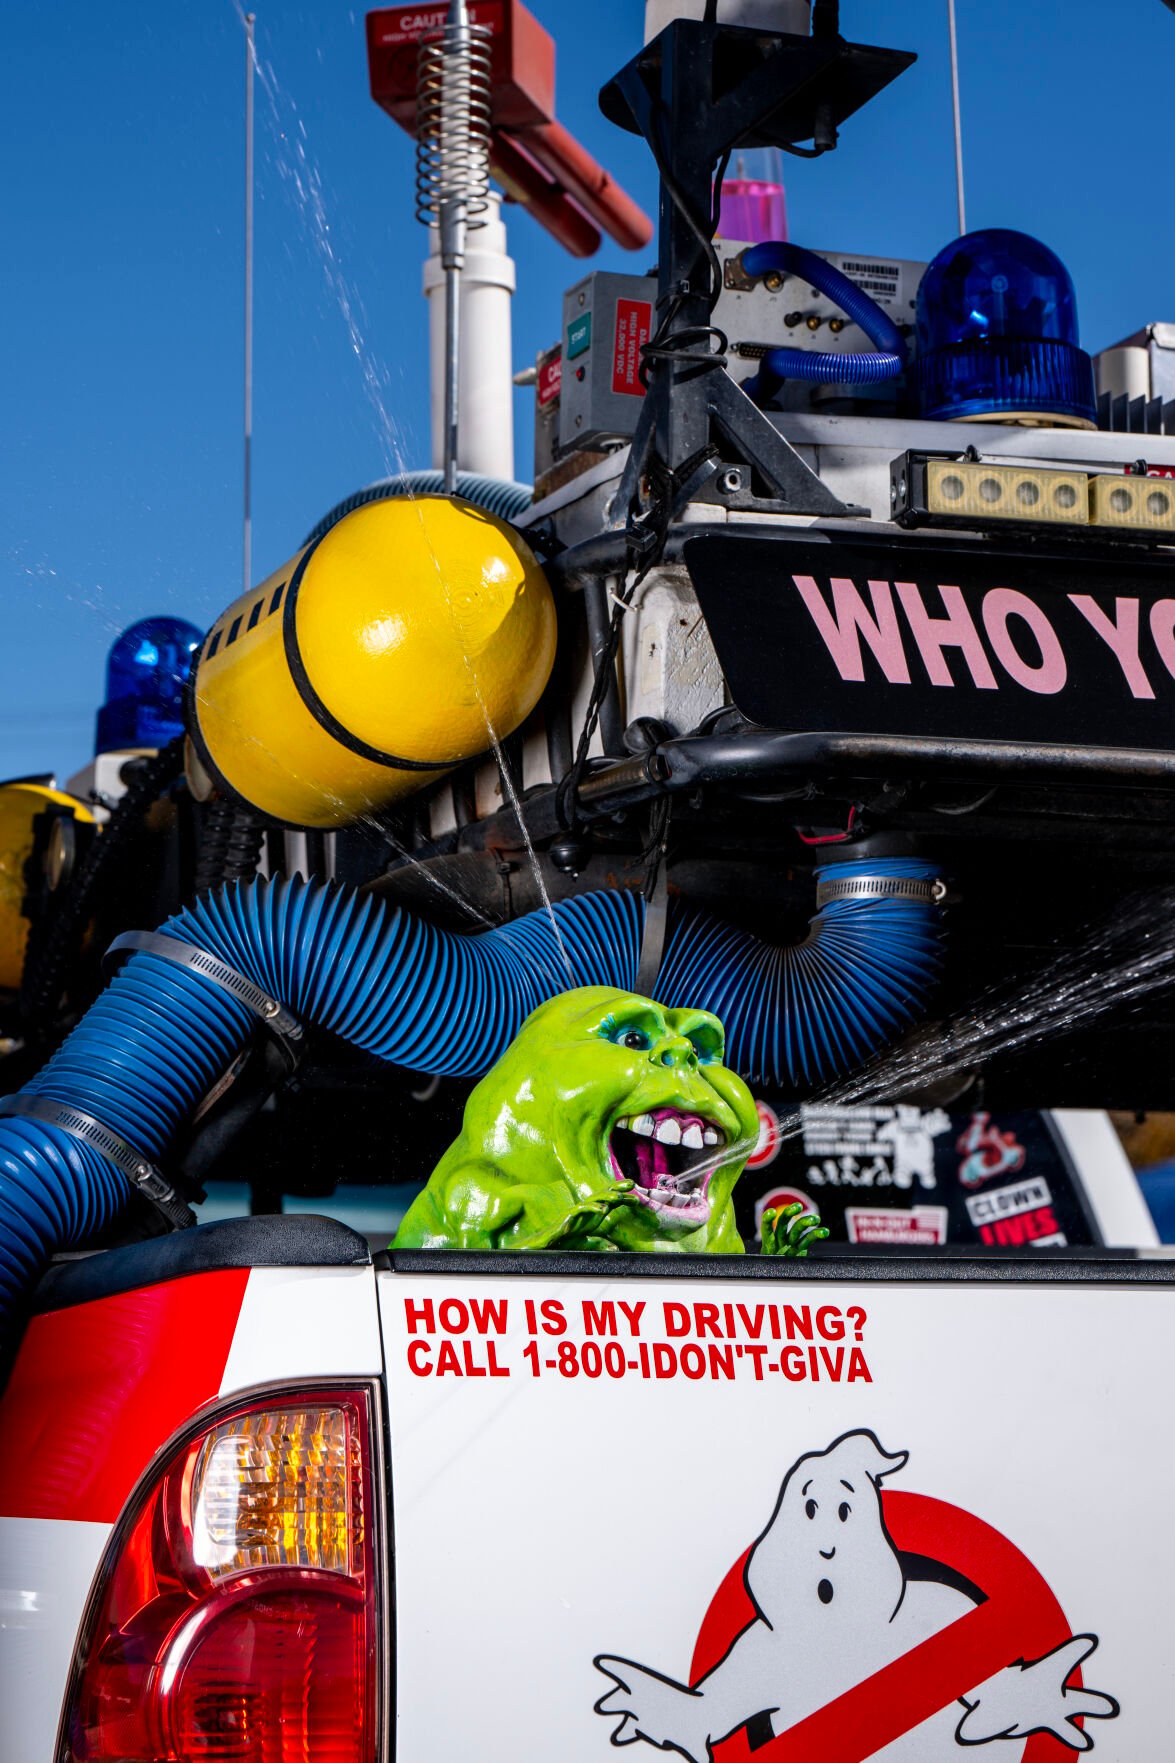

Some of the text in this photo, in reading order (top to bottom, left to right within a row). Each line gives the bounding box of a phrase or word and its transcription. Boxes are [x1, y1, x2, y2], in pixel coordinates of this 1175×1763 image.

[399, 8, 477, 31] CAUTN
[626, 339, 637, 384] VOLTAGE
[792, 575, 1067, 694] WHO
[974, 1184, 1045, 1217] CLOWN
[404, 1298, 867, 1341] HOW IS MY DRIVING?
[407, 1340, 872, 1383] CALL 1-800-IDON'T-GIVA
